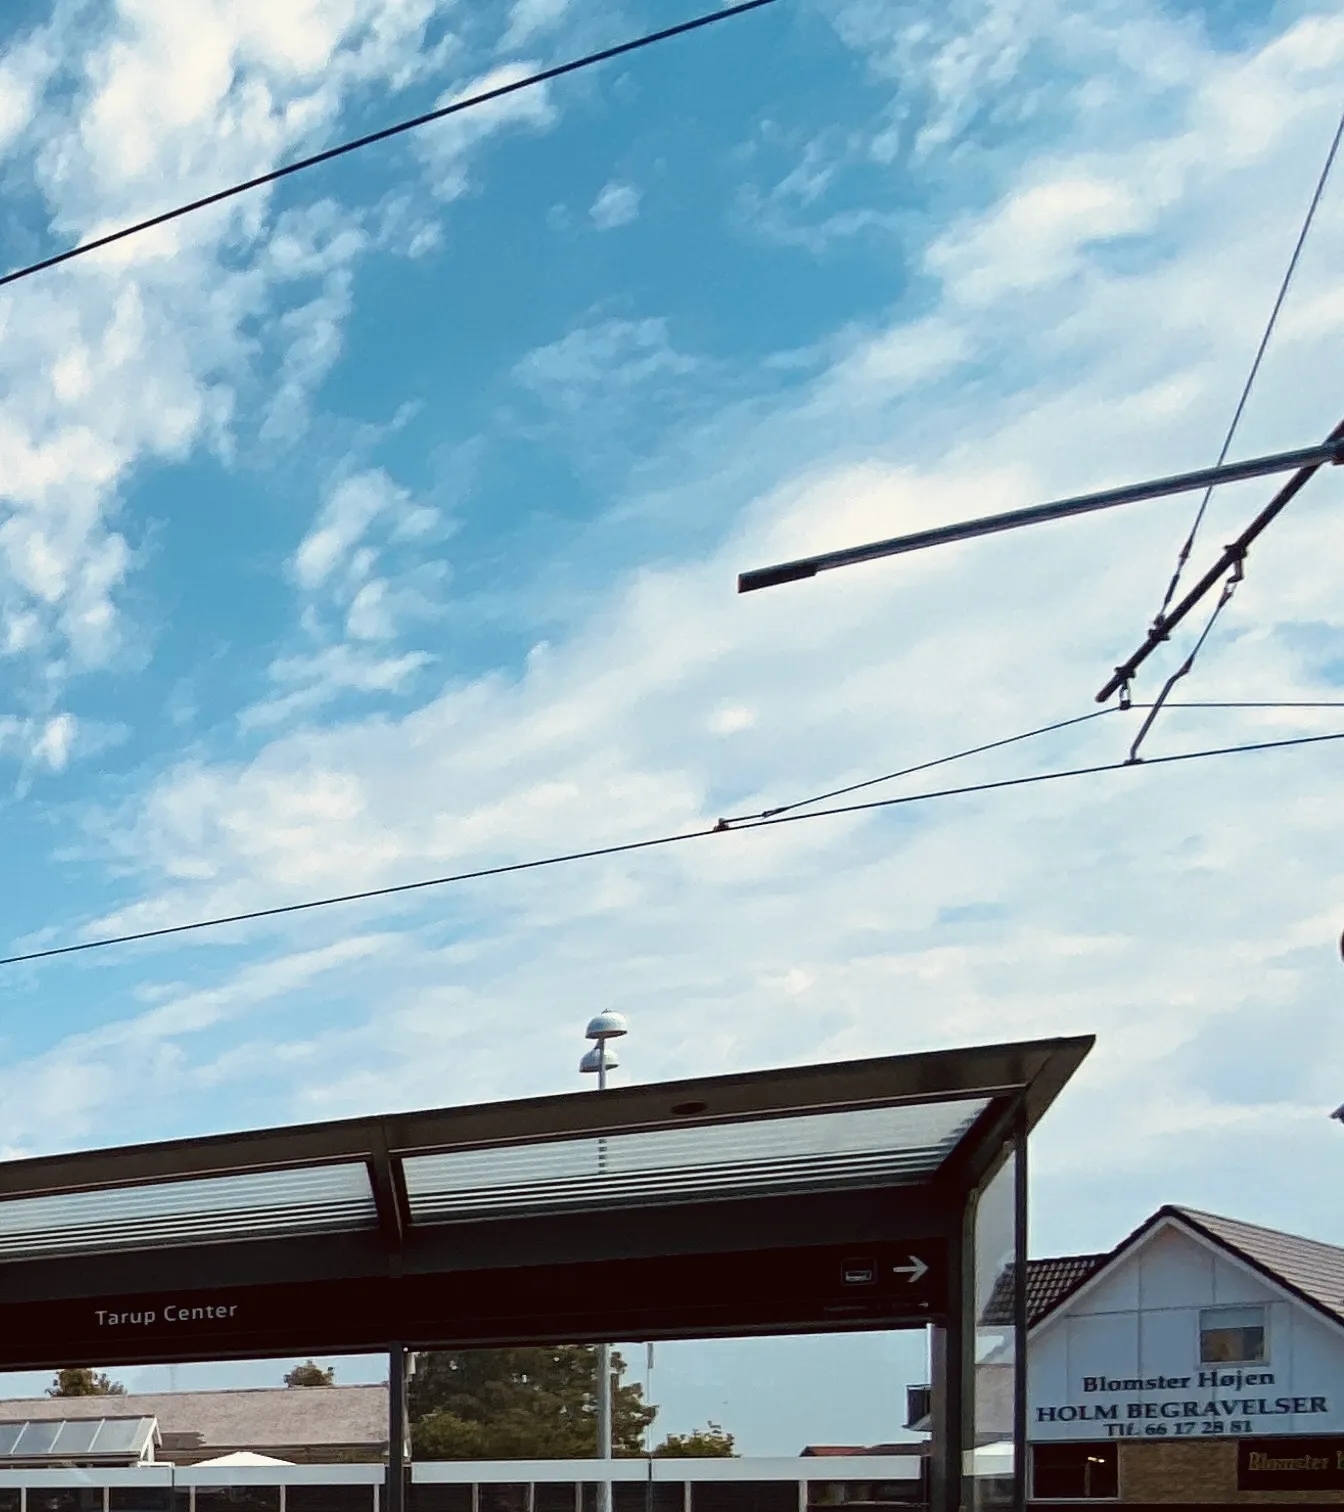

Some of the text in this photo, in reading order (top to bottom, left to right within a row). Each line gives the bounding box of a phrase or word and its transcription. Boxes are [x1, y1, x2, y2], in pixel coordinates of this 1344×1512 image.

[94, 1304, 238, 1326] Tarup Center
[1082, 1369, 1276, 1393] Blomster Højen
[1036, 1396, 1329, 1423] HOLM BEGRAVELSER
[1144, 1422, 1168, 1436] 66
[1173, 1421, 1196, 1435] 17
[1201, 1420, 1225, 1435] 28
